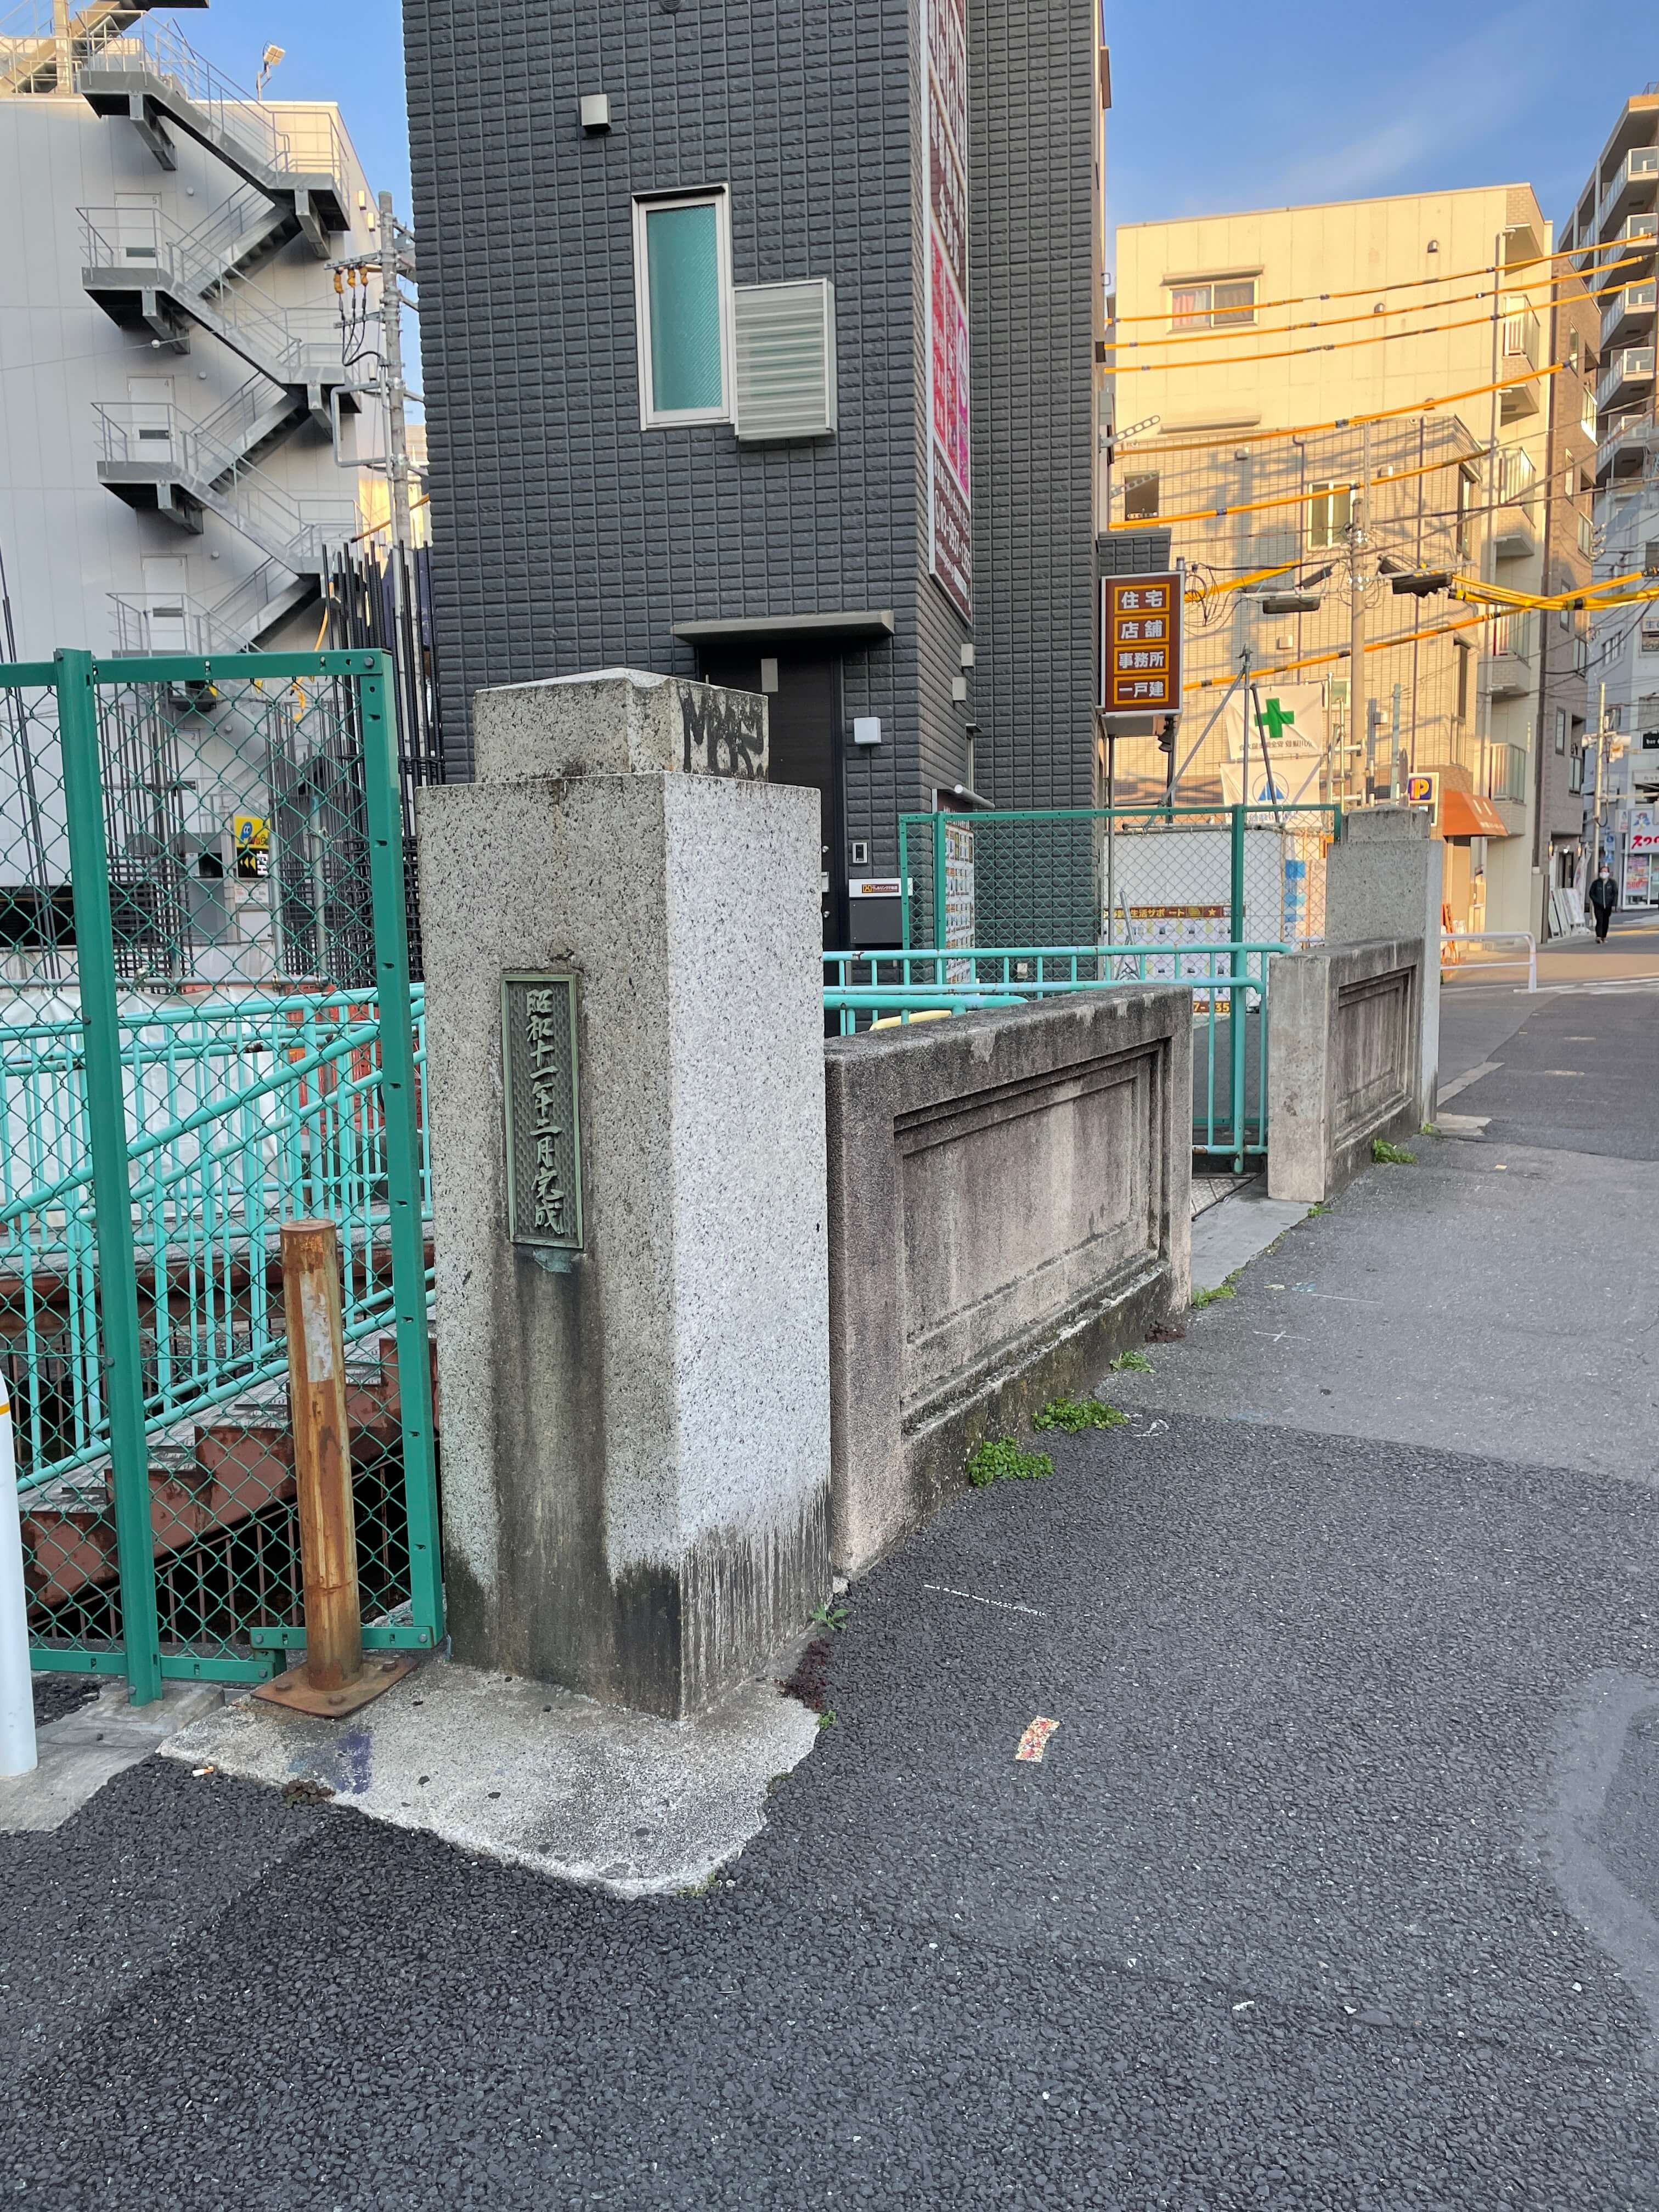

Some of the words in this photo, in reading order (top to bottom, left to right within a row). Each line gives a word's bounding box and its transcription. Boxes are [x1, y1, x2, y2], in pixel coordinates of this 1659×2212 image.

[1121, 590, 1163, 609] 住宅
[1121, 620, 1163, 639] 店舗
[1119, 651, 1164, 668] 事務所
[1119, 681, 1164, 697] 一戸建
